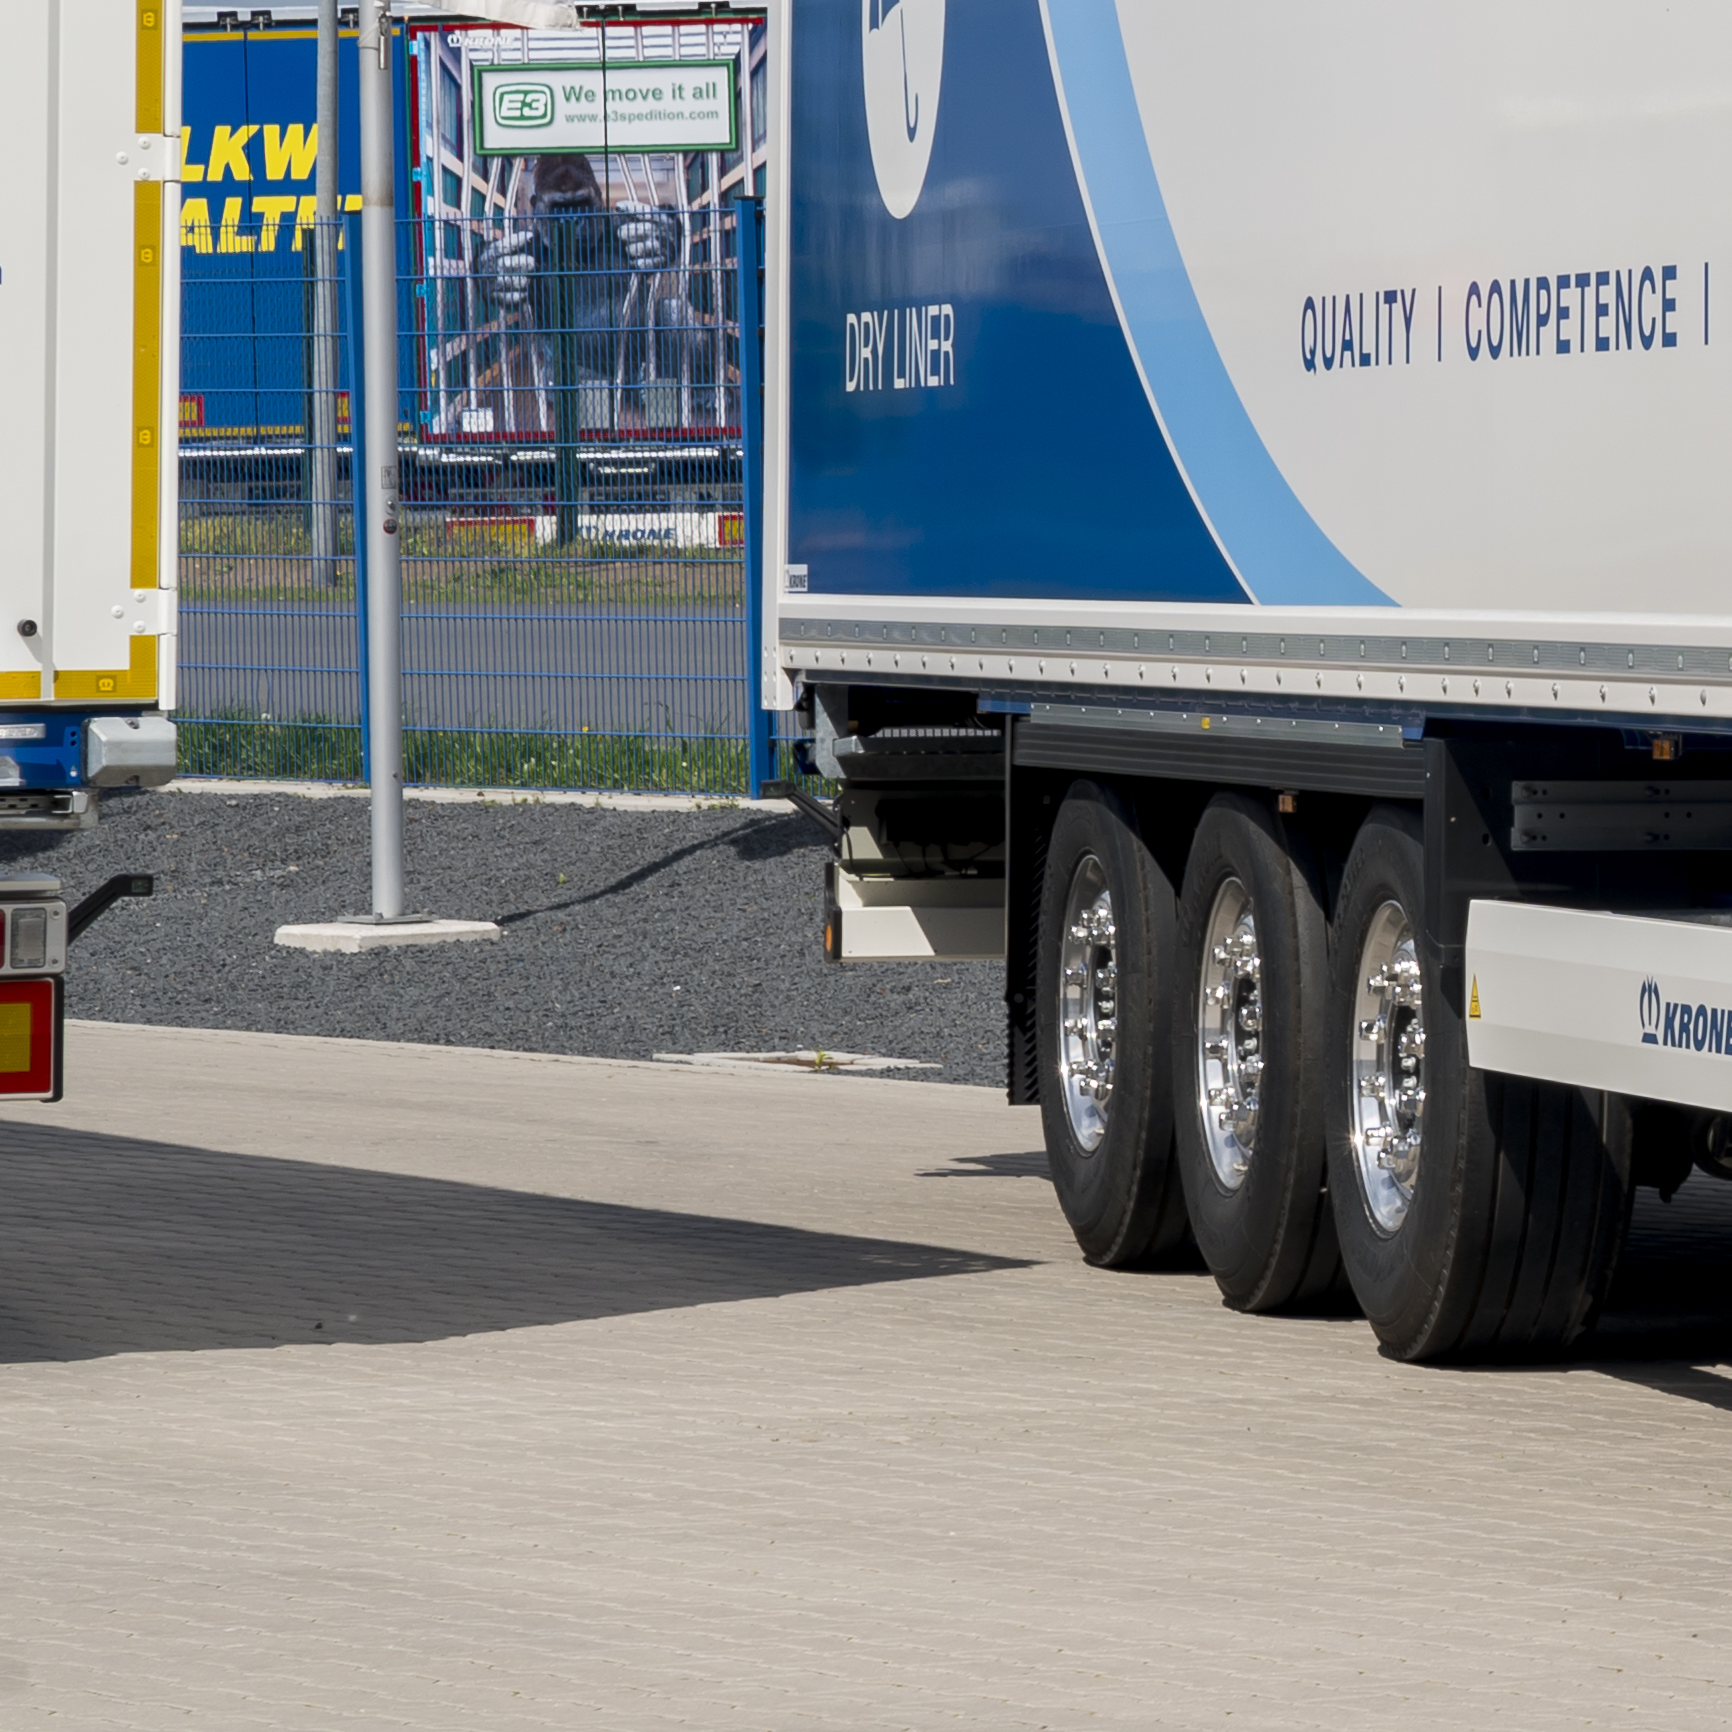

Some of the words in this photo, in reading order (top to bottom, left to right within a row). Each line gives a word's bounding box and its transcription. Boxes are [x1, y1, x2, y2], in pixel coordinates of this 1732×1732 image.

[500, 93, 548, 117] E3
[562, 85, 596, 103] We
[606, 87, 663, 102] move
[672, 83, 685, 100] it
[692, 82, 717, 100] all
[565, 110, 719, 125] www.e3spedition.com
[181, 124, 318, 182] LKW
[1302, 288, 1416, 376] QUALITY
[1466, 265, 1678, 362] COMPETENCE
[846, 310, 888, 392] DRY
[894, 304, 954, 389] LINER
